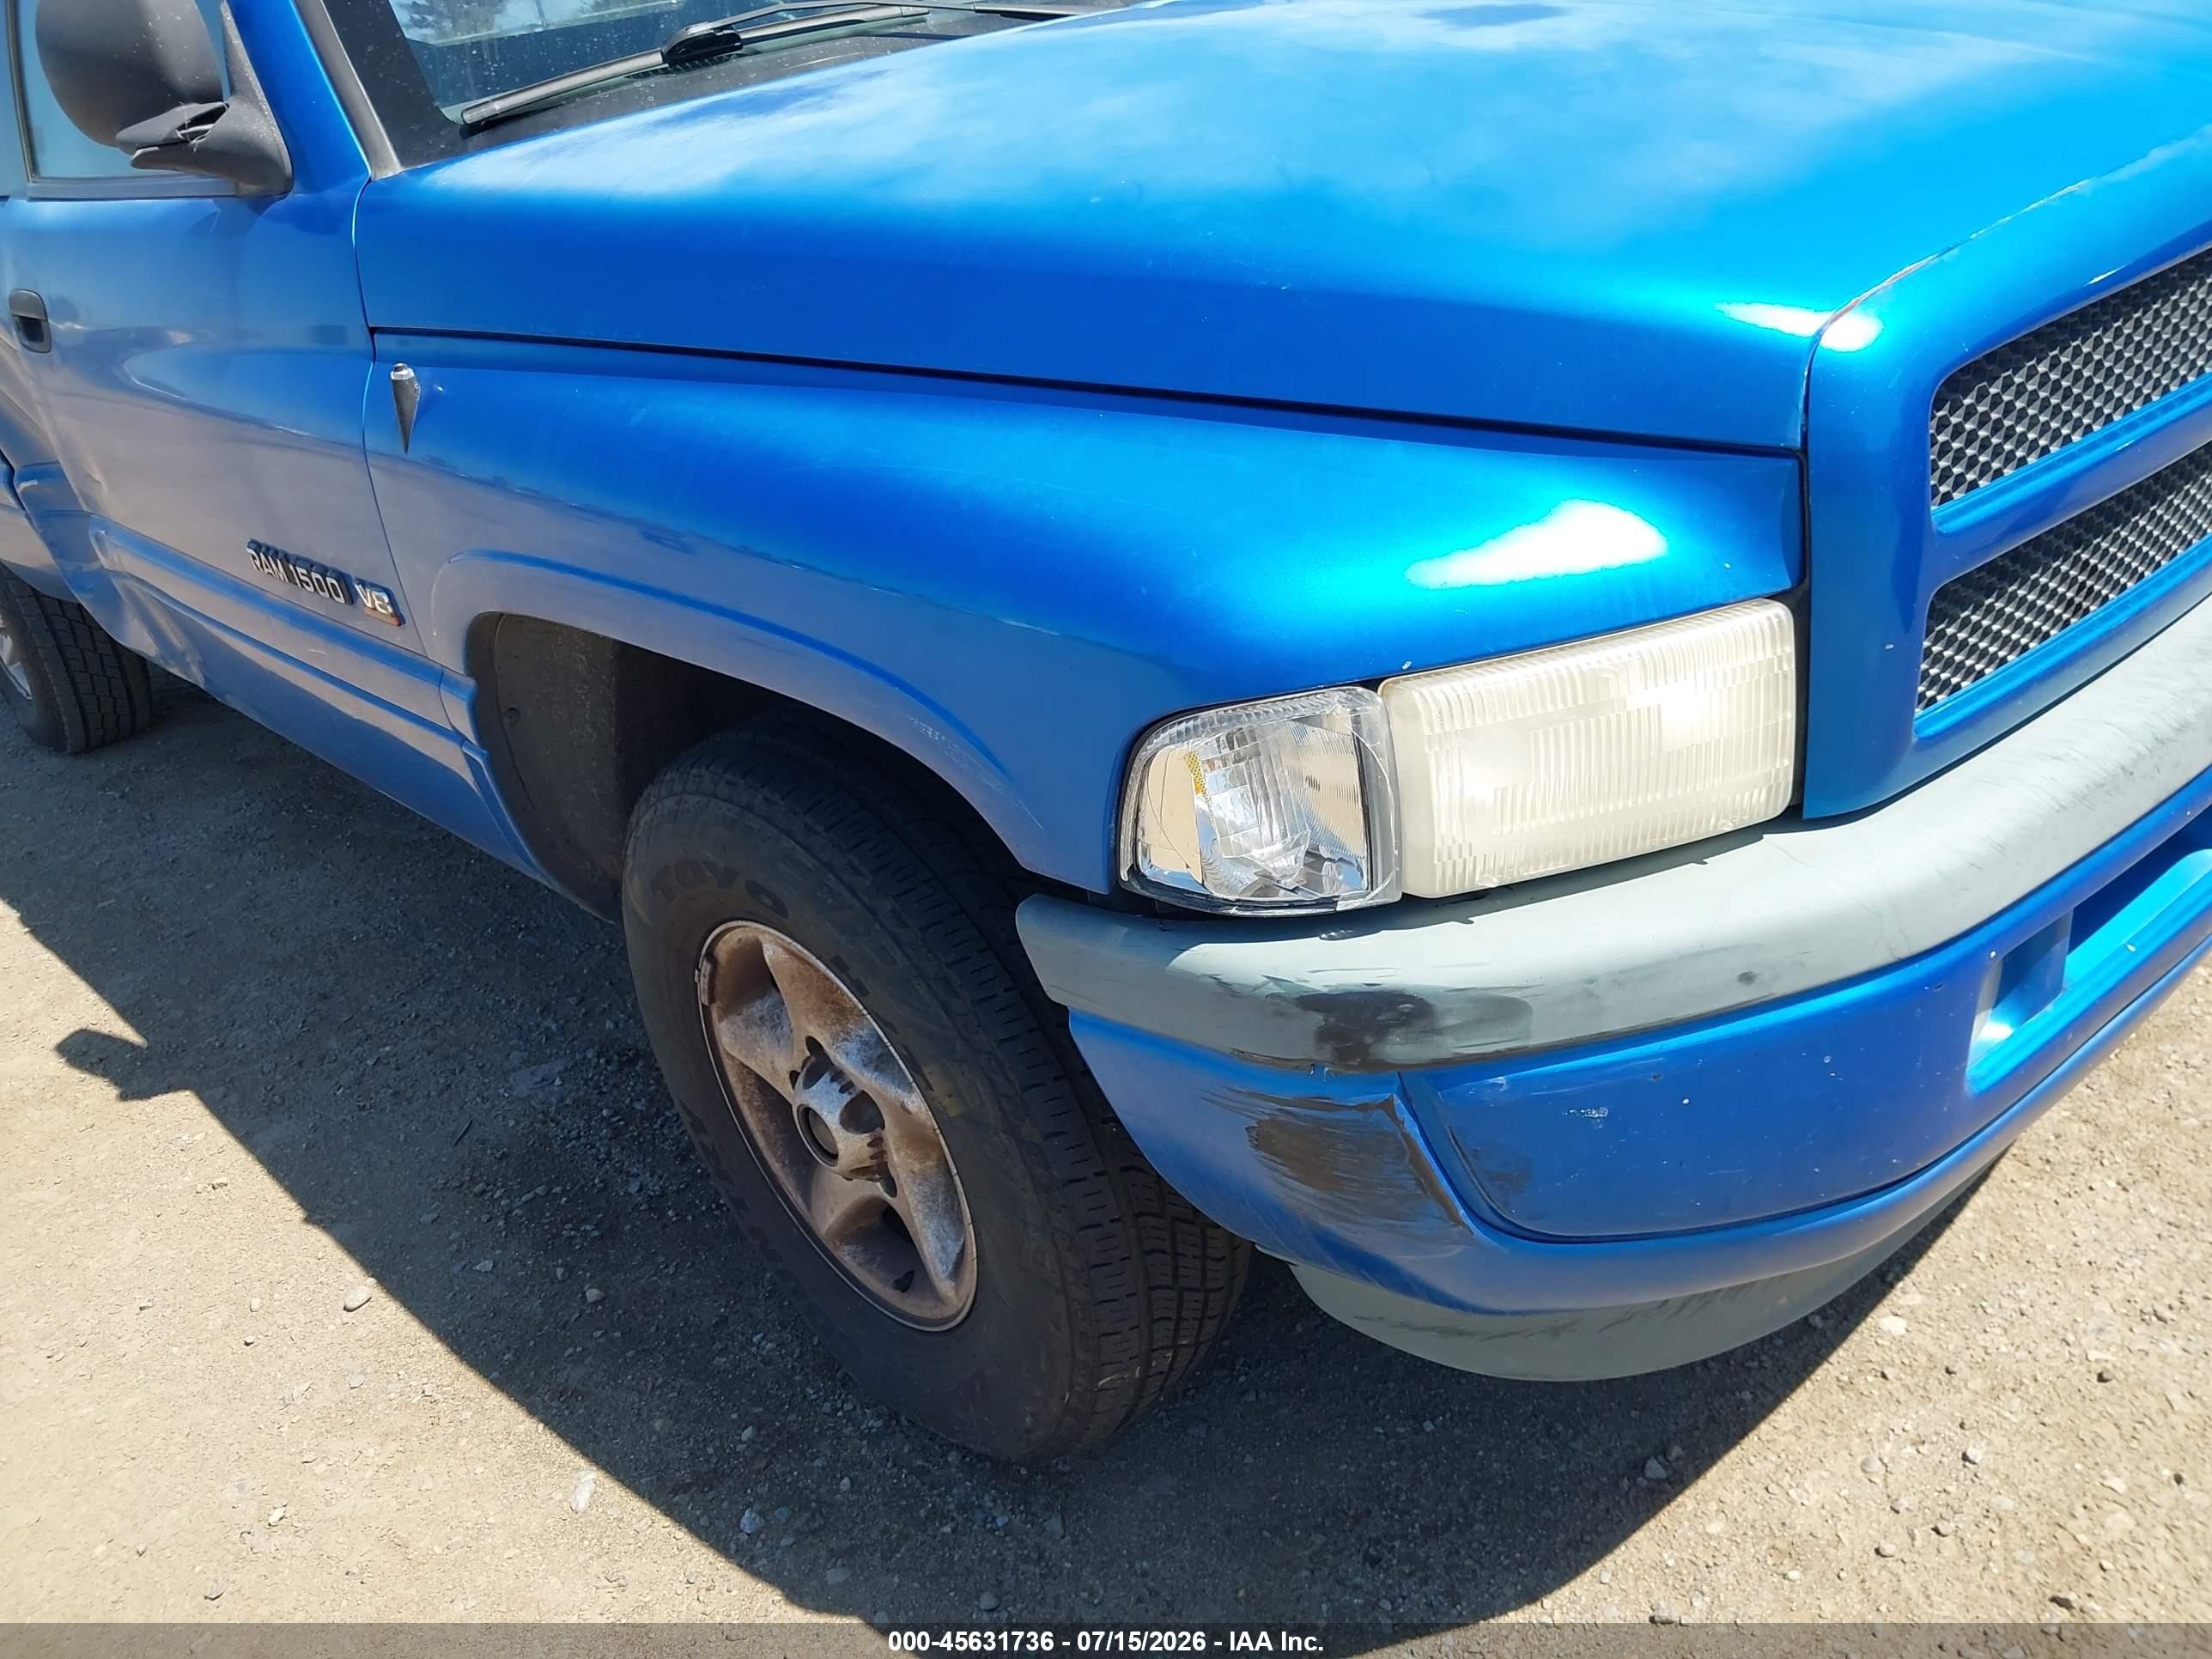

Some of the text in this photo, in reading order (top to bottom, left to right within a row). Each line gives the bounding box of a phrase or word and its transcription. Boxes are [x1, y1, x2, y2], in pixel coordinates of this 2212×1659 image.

[246, 547, 395, 616] RAM 1500 V8
[650, 859, 790, 920] TOYO
